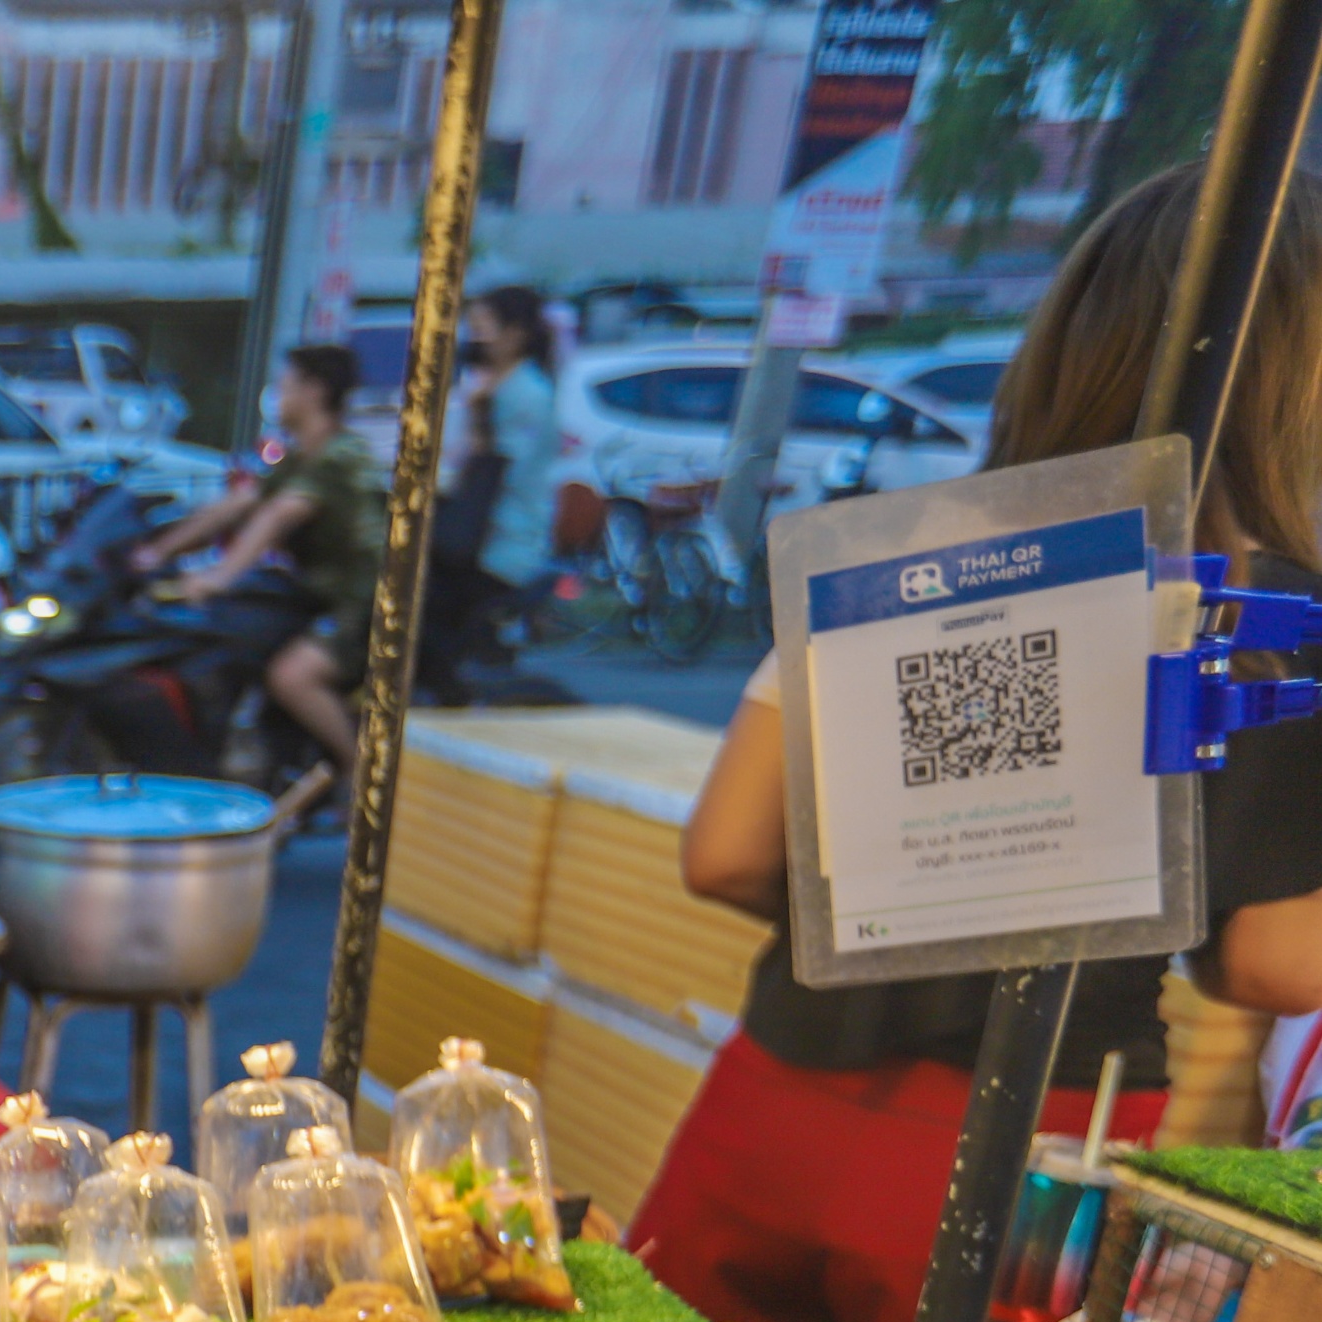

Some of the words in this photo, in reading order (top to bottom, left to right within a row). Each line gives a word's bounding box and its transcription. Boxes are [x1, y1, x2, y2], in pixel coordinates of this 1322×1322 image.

[959, 550, 1006, 573] THAI
[1012, 545, 1042, 563] QR
[958, 561, 1043, 588] PAYMENT
